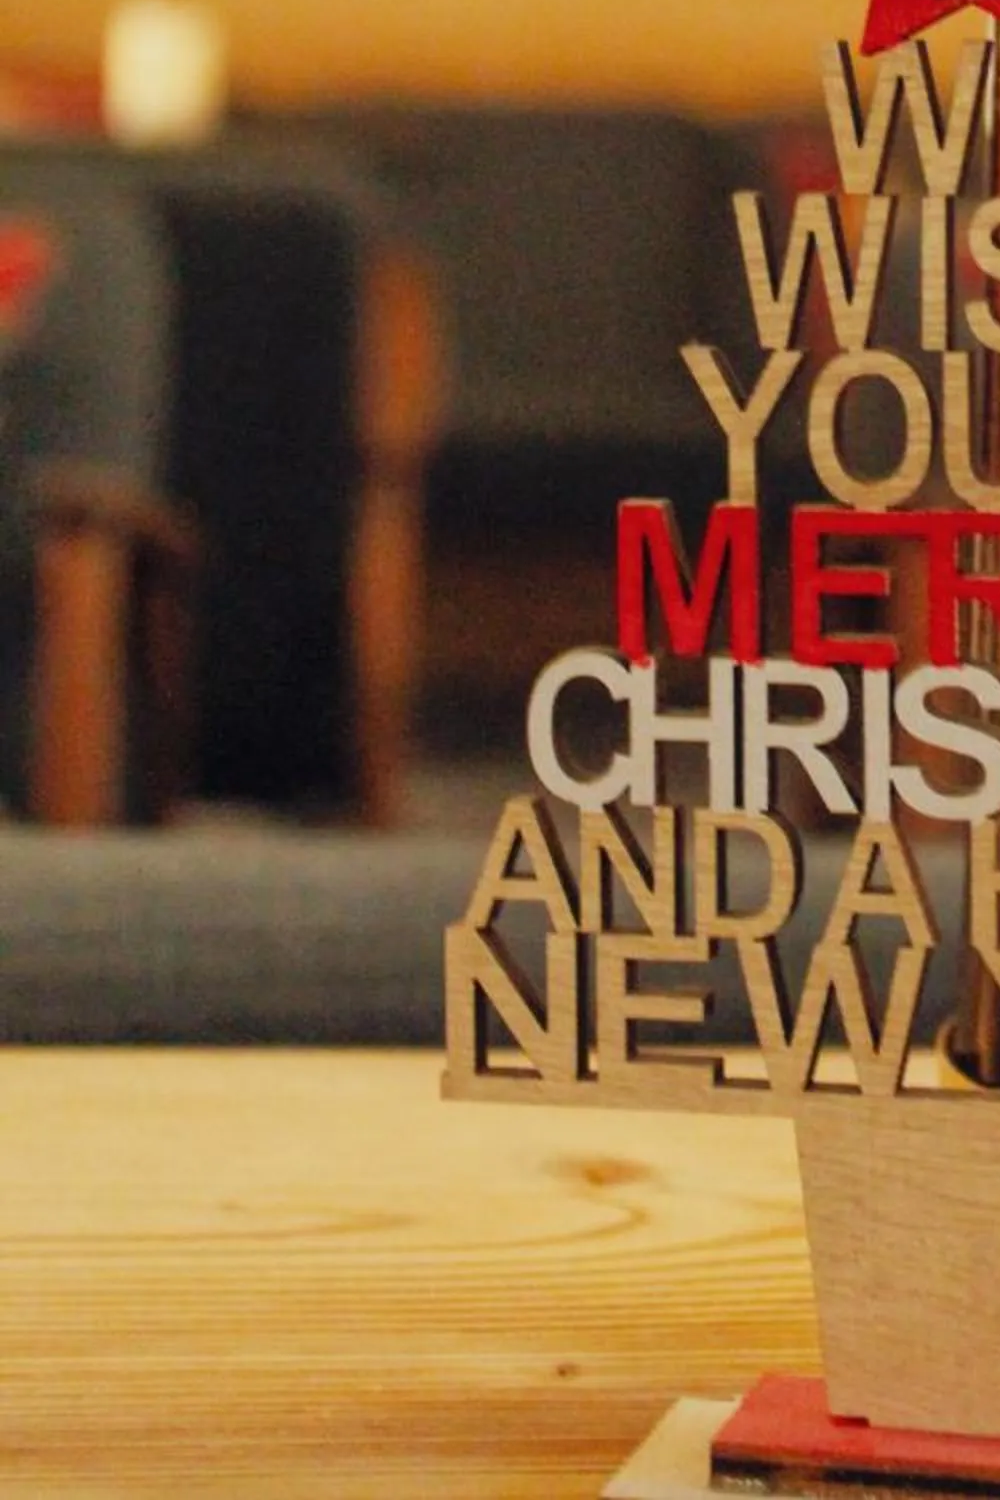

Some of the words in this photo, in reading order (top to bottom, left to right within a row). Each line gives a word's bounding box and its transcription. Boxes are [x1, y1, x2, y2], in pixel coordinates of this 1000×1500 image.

[464, 796, 798, 944] AND
[822, 818, 936, 952] A
[444, 926, 934, 1098] NEW
